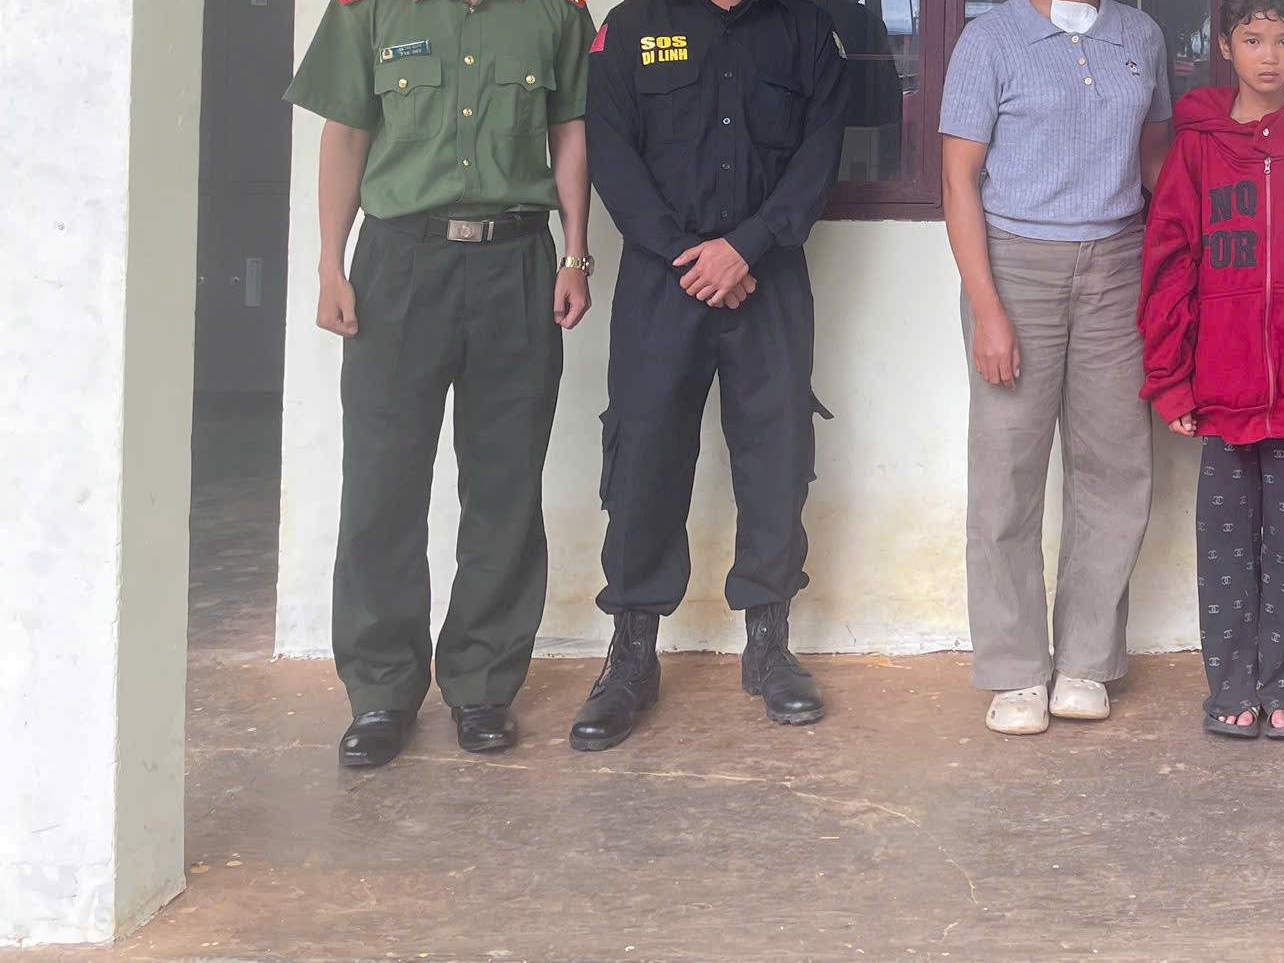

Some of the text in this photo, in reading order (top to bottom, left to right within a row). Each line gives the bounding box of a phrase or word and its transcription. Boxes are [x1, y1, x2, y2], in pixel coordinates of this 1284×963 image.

[640, 35, 688, 50] SOS
[641, 48, 688, 66] DI LINH
[1203, 229, 1258, 270] OR
